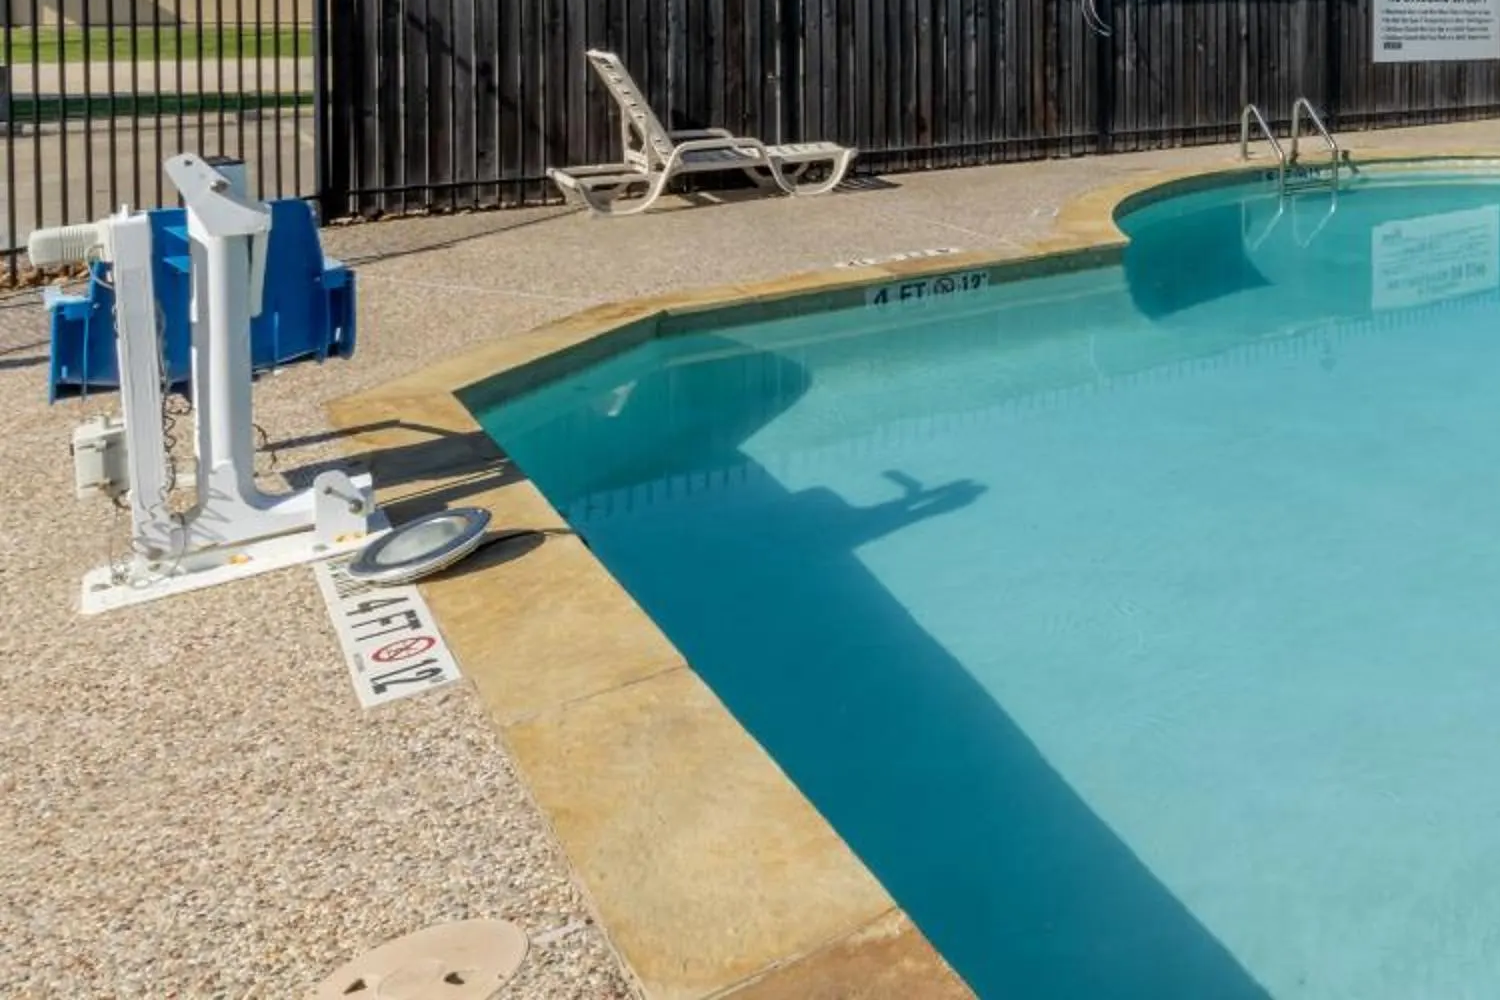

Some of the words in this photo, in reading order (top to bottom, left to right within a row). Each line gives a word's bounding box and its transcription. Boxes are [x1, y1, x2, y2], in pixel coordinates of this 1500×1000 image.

[873, 288, 889, 305] 4
[899, 281, 928, 300] FT
[345, 596, 409, 617] 4
[350, 609, 422, 643] FT
